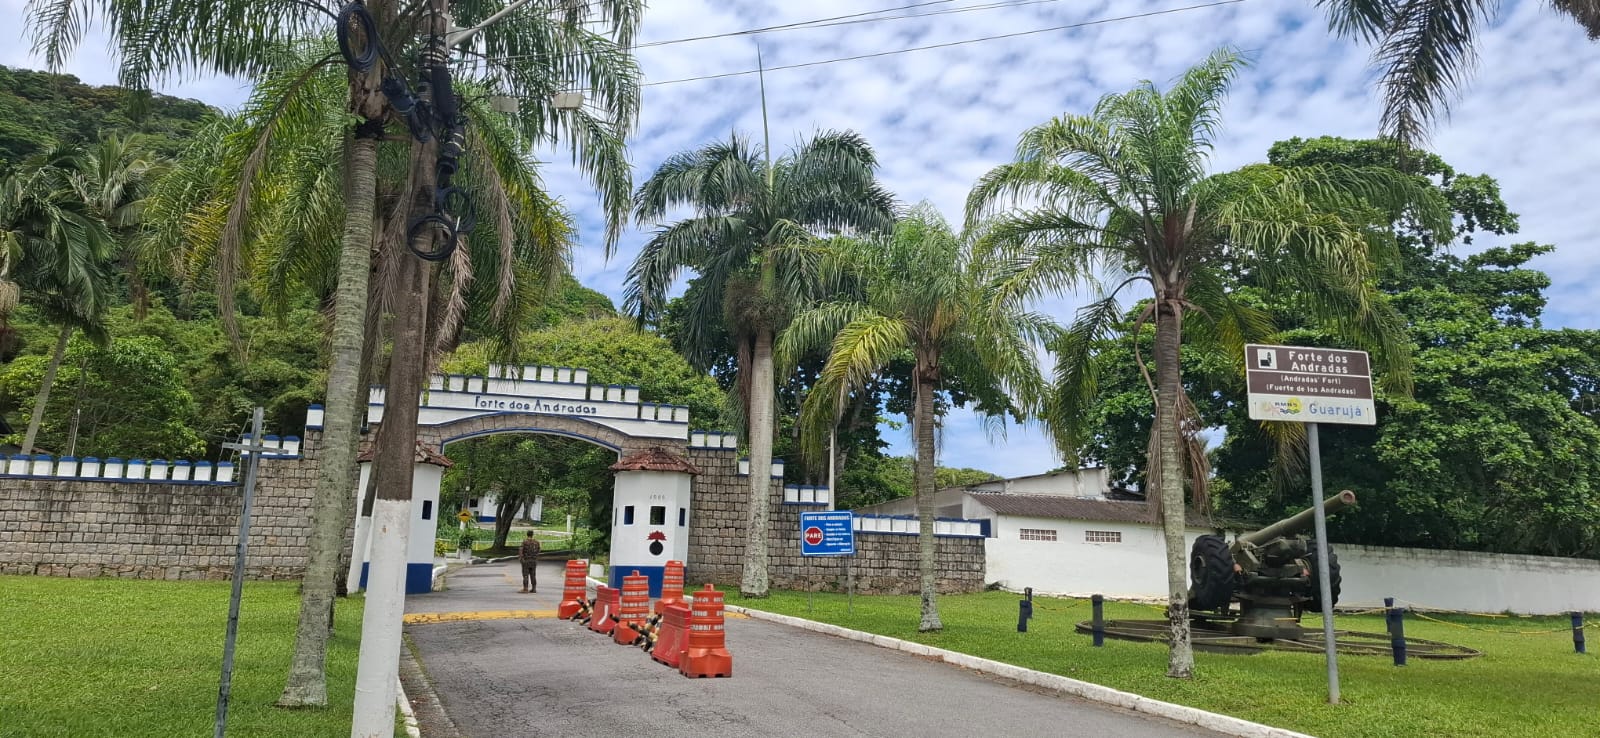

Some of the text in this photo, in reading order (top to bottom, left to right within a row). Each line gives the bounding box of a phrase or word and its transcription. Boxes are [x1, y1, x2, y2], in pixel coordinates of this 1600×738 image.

[1289, 351, 1348, 364] Forte dos
[1291, 361, 1348, 374] Andradas
[1296, 384, 1305, 392] de
[1307, 385, 1318, 393] los
[475, 395, 597, 414] Forte dos Andradas
